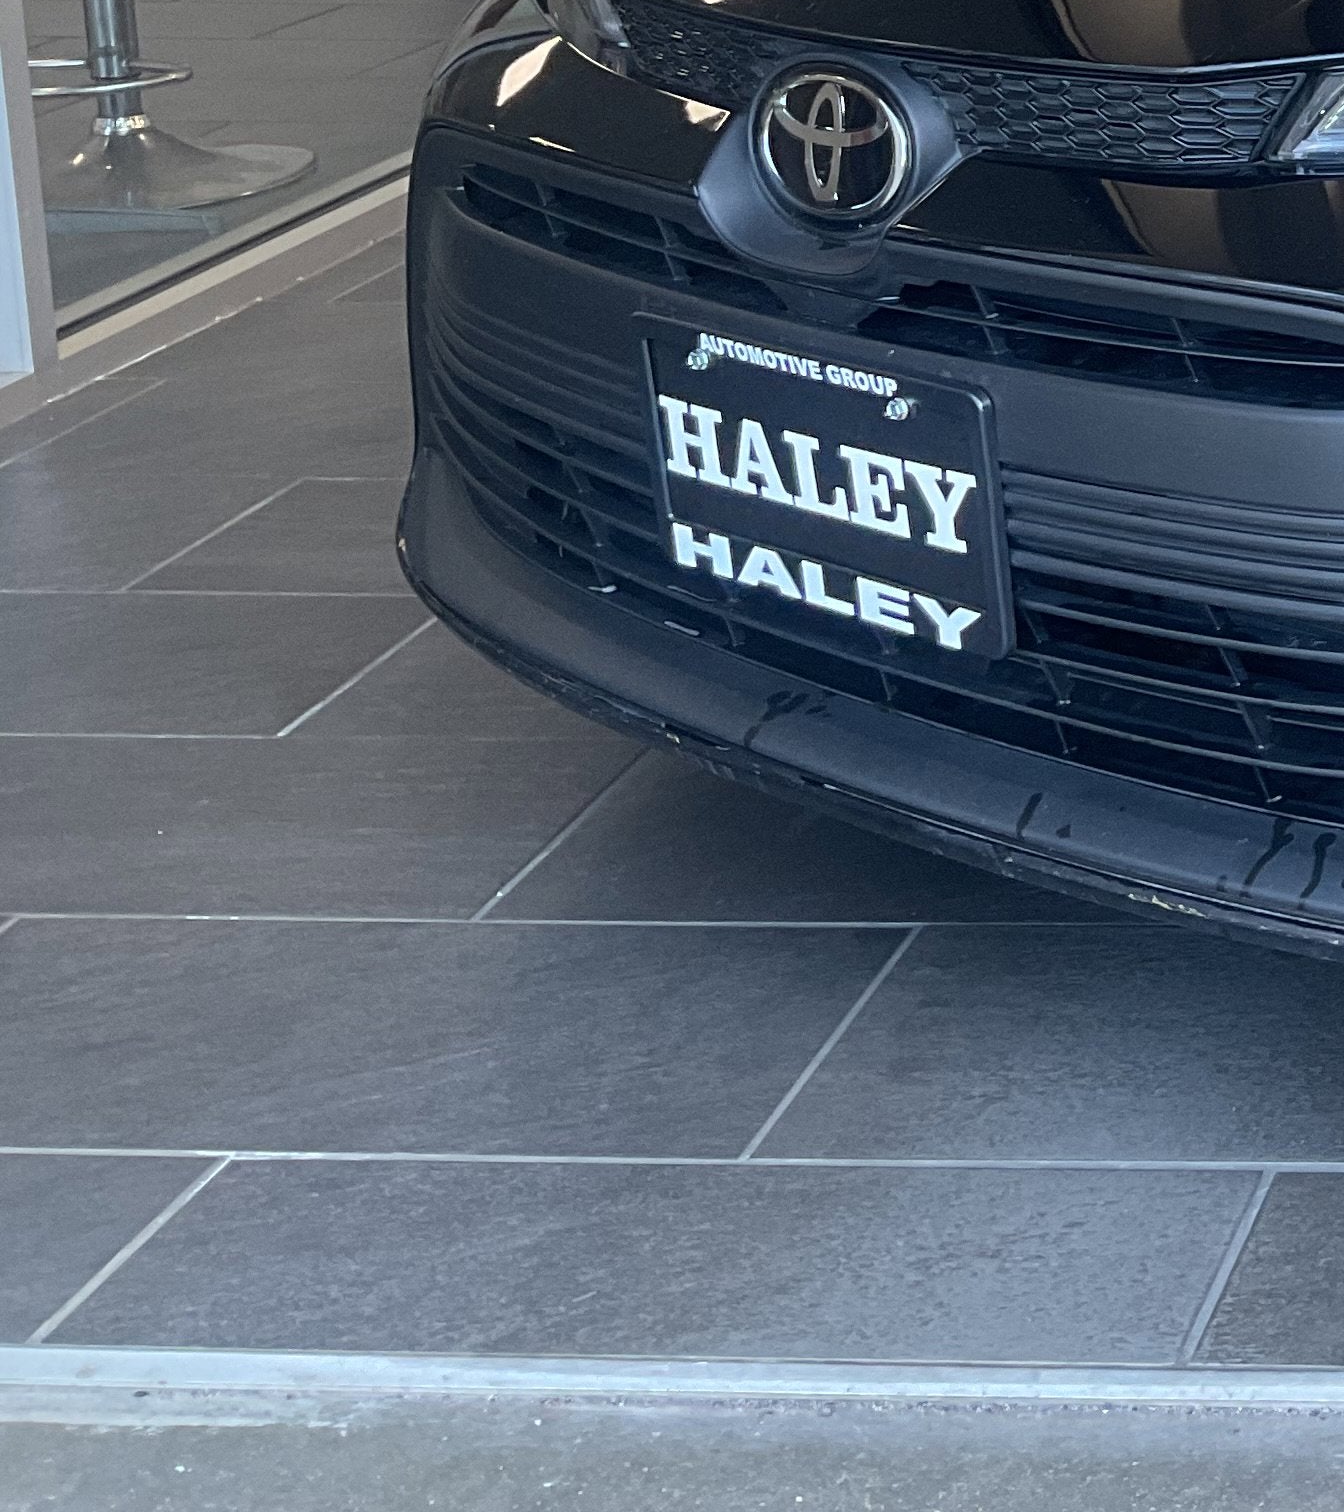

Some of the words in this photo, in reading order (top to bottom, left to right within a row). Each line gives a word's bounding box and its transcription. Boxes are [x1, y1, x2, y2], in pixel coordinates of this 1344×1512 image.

[698, 332, 823, 382] AUTOMOTIVE
[825, 363, 899, 398] GROUP
[658, 393, 977, 555] HALEY
[671, 521, 982, 651] HALEY
